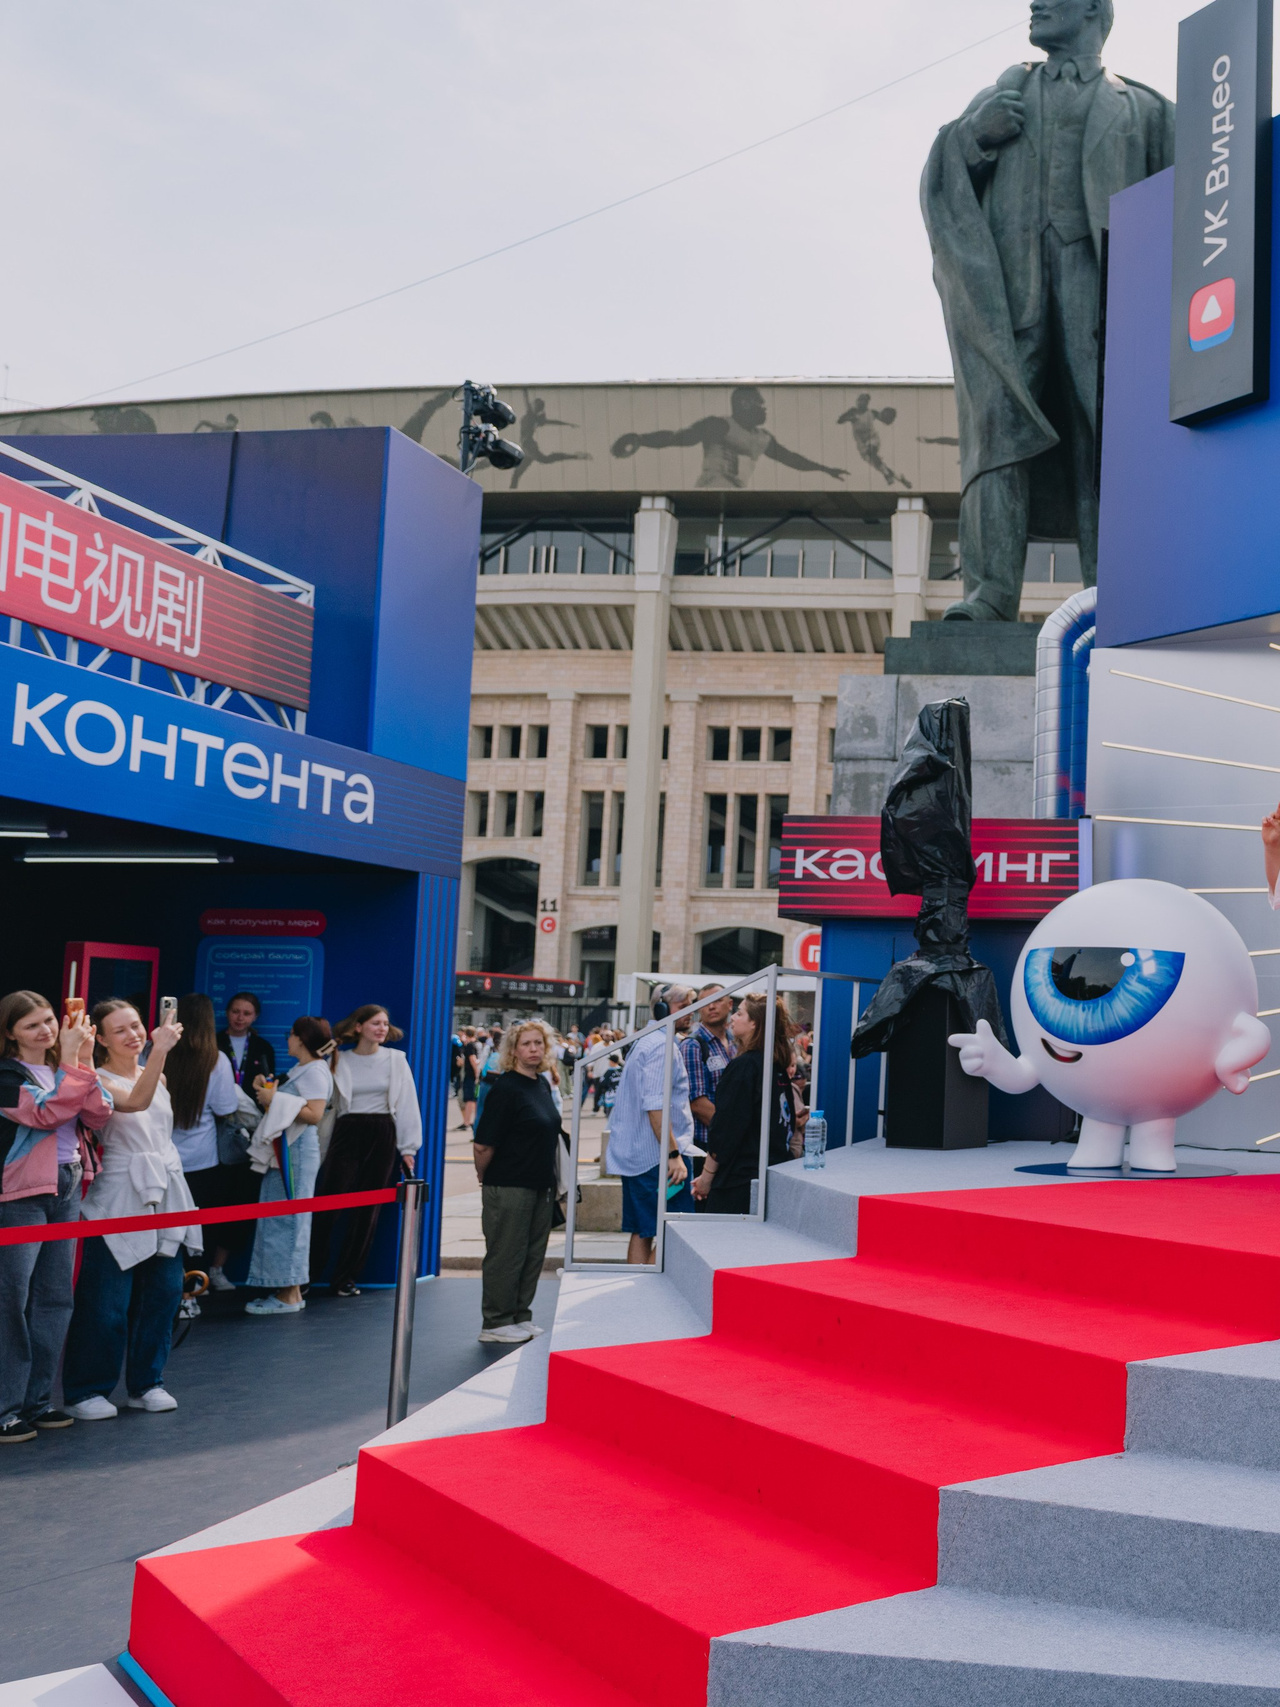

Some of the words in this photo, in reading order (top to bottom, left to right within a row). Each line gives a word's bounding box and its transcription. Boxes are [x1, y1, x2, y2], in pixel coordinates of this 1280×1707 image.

[1205, 54, 1235, 196] Видео
[1203, 199, 1229, 267] VK
[12, 682, 375, 825] контента
[229, 918, 285, 927] получить
[287, 919, 320, 928] мерч
[540, 899, 558, 912] 11
